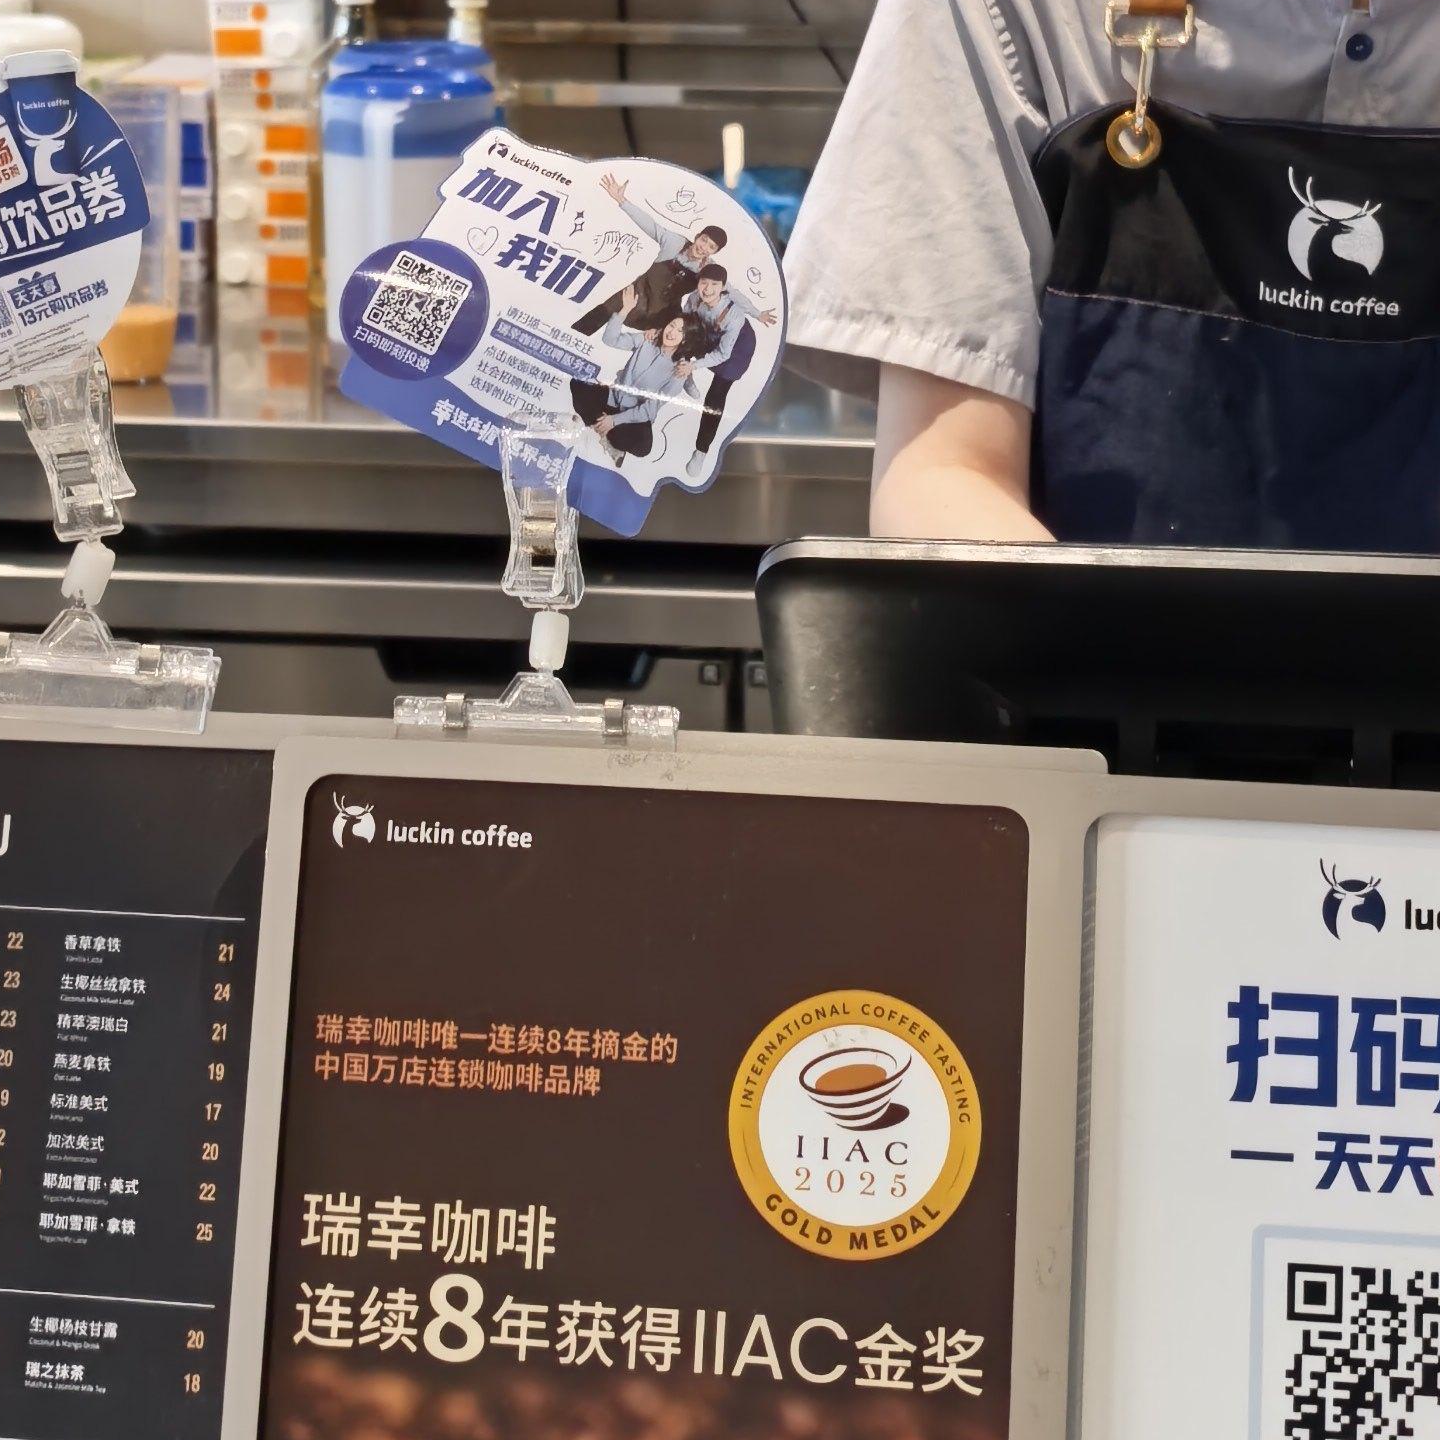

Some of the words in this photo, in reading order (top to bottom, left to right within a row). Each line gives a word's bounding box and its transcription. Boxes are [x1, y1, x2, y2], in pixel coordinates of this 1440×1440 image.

[509, 154, 540, 174] luckin
[540, 166, 573, 187] coffee
[456, 165, 561, 237] 加入
[493, 232, 606, 304] 我们
[17, 278, 110, 328] 13元购饮品券
[1258, 280, 1325, 314] luckin
[1329, 294, 1401, 319] coffee
[386, 819, 456, 847] luckin
[460, 822, 534, 850] coffee
[6, 930, 25, 951] 22
[64, 934, 122, 953] 香草拿铁
[218, 943, 235, 963] 21
[2, 970, 22, 990] 23
[213, 982, 232, 1002] 24
[0, 1009, 17, 1029] 23
[211, 1022, 227, 1042] 21
[315, 1013, 679, 1066] 瑞幸咖啡唯一连续8年摘金的
[208, 1062, 226, 1082] 19
[313, 1051, 602, 1099] 中国万店连锁咖啡品牌
[739, 1001, 853, 1111] INTERNATIONAL
[859, 1001, 931, 1046] COFFEE
[930, 1042, 972, 1125] TASTING
[49, 1093, 109, 1113] 标准美式
[204, 1102, 222, 1122] 17
[45, 1131, 105, 1152] 加浓美式
[201, 1142, 220, 1162] 20
[795, 1134, 910, 1167] IIAC
[198, 1182, 217, 1202] 22
[793, 1165, 910, 1200] 2025
[195, 1222, 214, 1242] 25
[299, 1190, 558, 1272] 瑞幸咖啡
[764, 1190, 835, 1248] GOLD
[848, 1201, 943, 1252] MEDAL
[186, 1329, 206, 1350] 20
[292, 1272, 986, 1398] 连续8年获得IIAC金奖
[183, 1372, 202, 1394] 18
